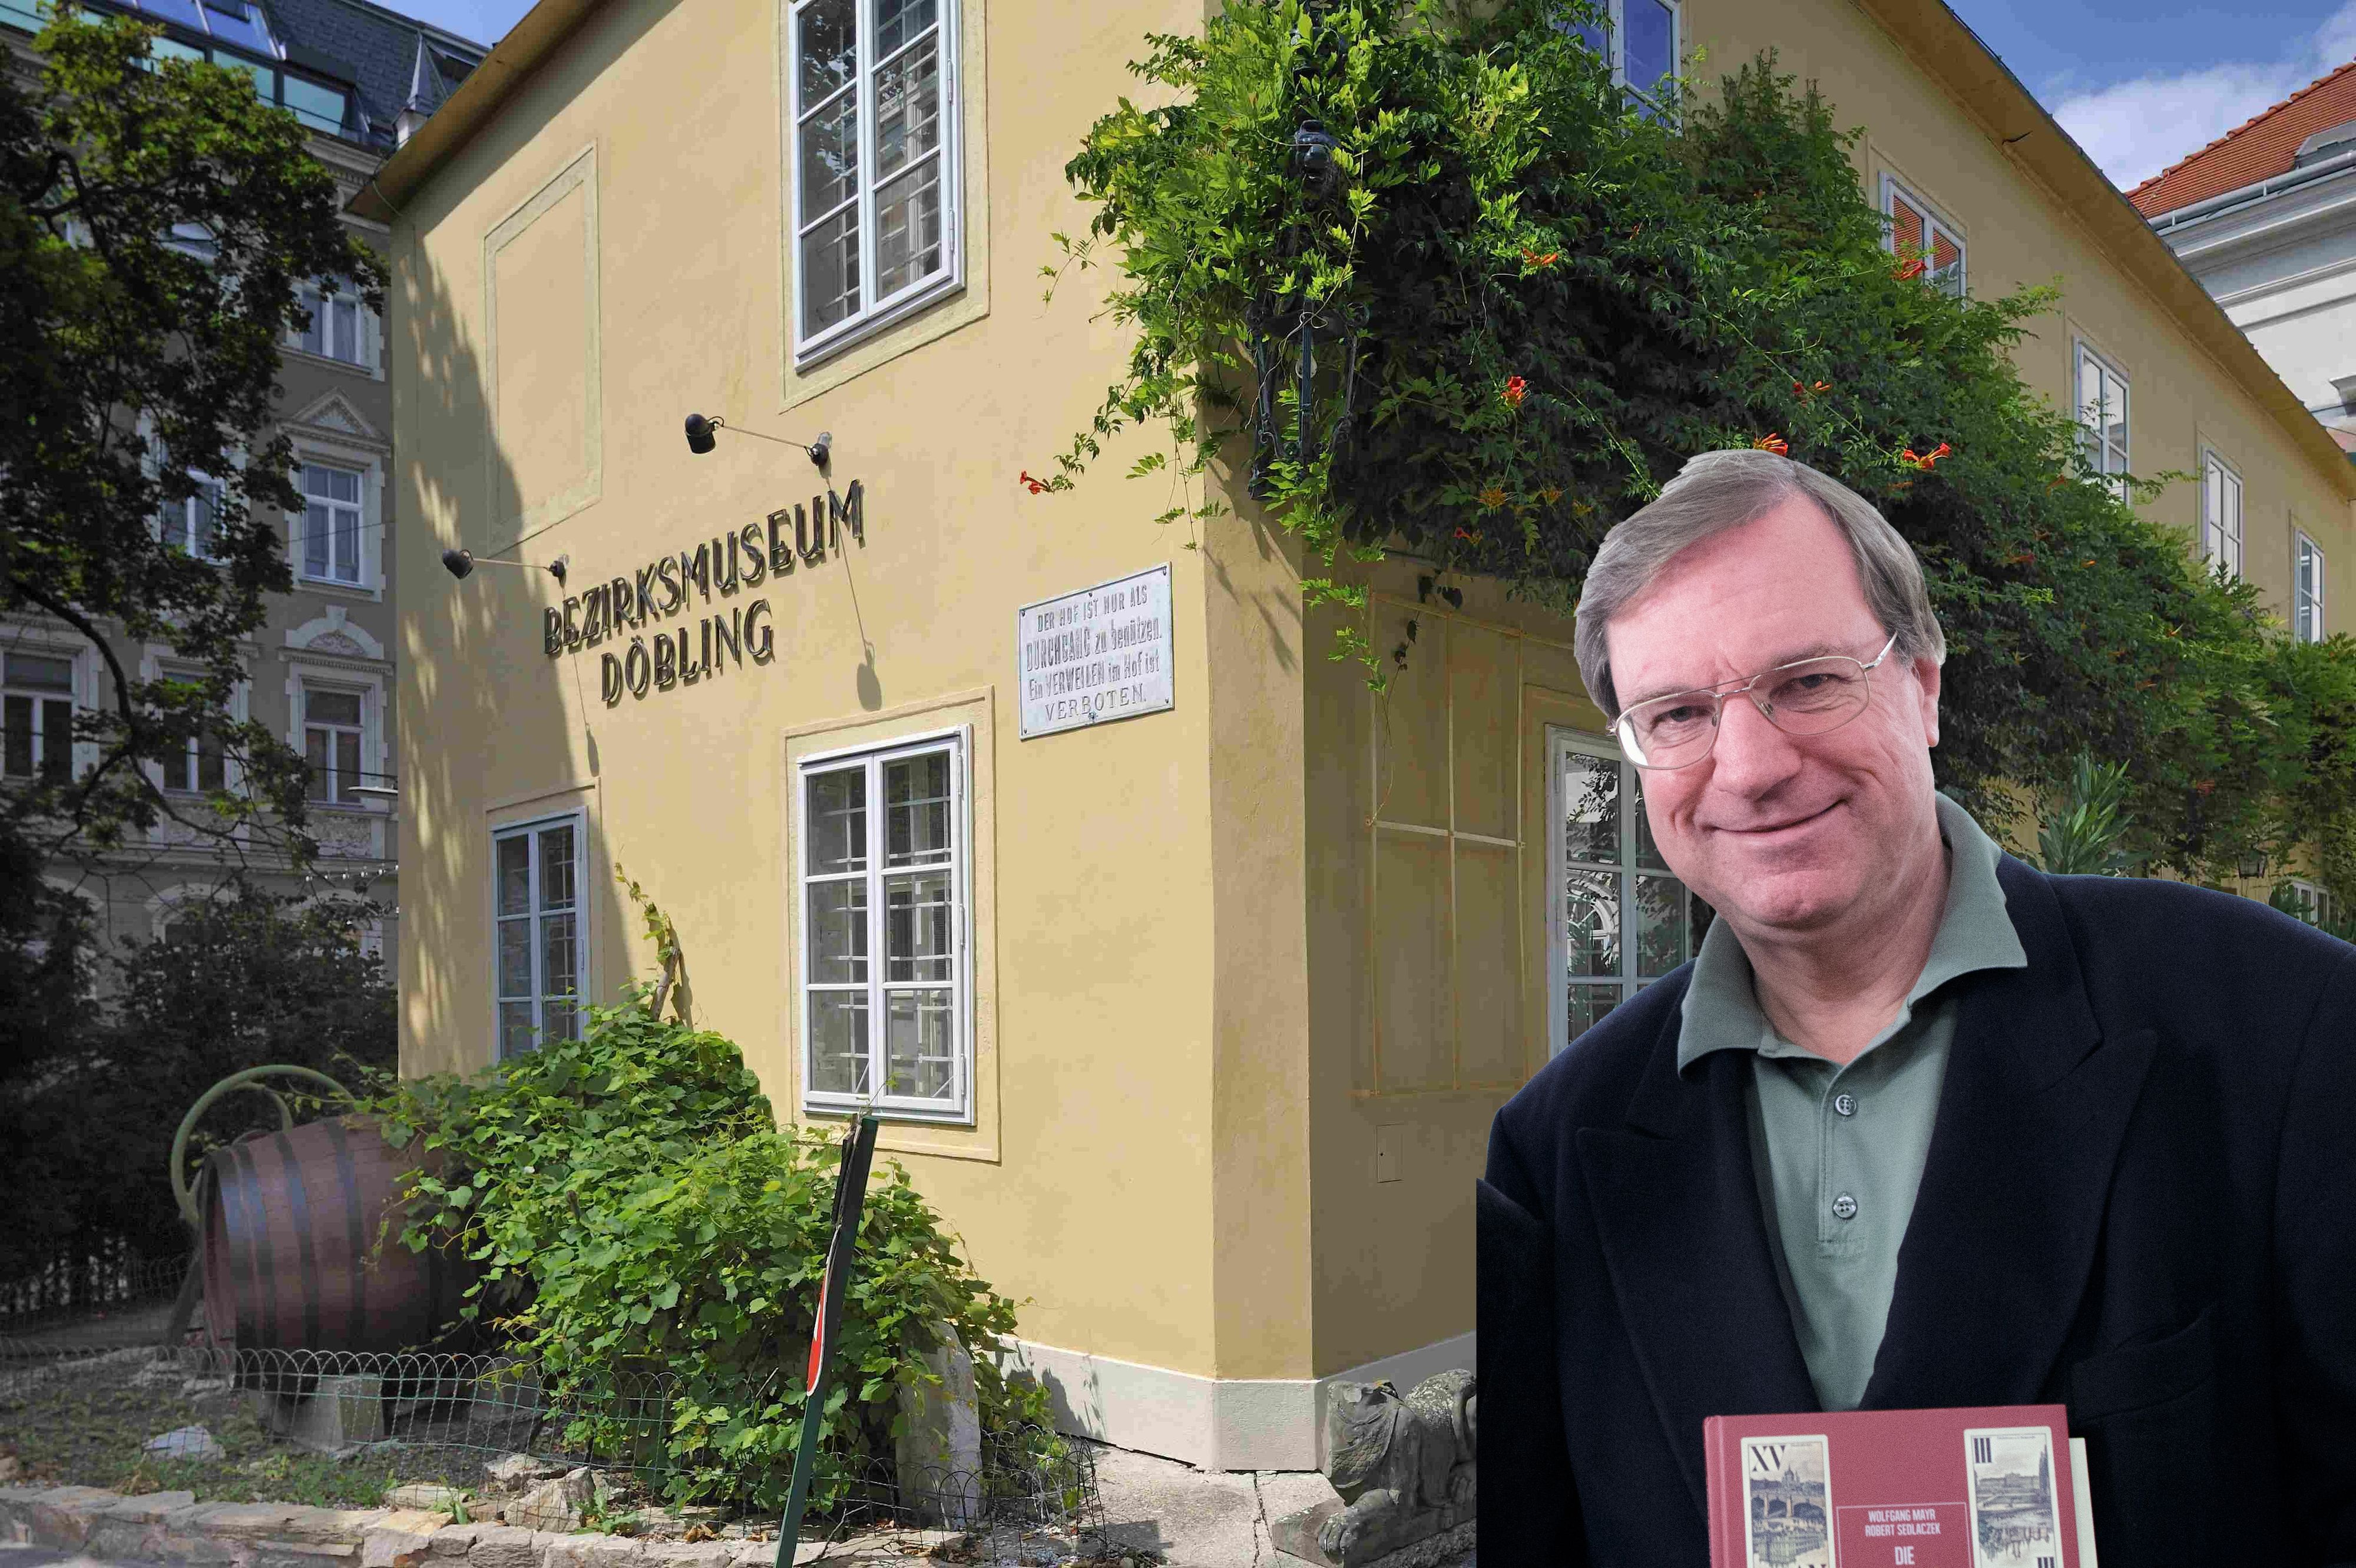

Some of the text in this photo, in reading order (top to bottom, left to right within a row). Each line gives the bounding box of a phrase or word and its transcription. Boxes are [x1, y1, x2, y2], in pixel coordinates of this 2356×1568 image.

[544, 479, 863, 654] BEZIRKSMUSEUM
[1038, 584, 1147, 632] DER HOF IST NUR ALS
[601, 598, 773, 702] DÖBLING
[1027, 627, 1090, 671] DURCHGANG
[1095, 631, 1107, 654] zu
[1029, 649, 1159, 700] Ein VERWEILEN im Hof ist
[1045, 683, 1146, 721] VERBOTEN.
[1751, 1445, 1785, 1471] XV
[1974, 1437, 1992, 1463] III
[1865, 1523, 1941, 1537] ROBERT SEDLACZEK
[1868, 1509, 1935, 1523] WOLFGANG MAYR
[1894, 1546, 1915, 1565] DIE
